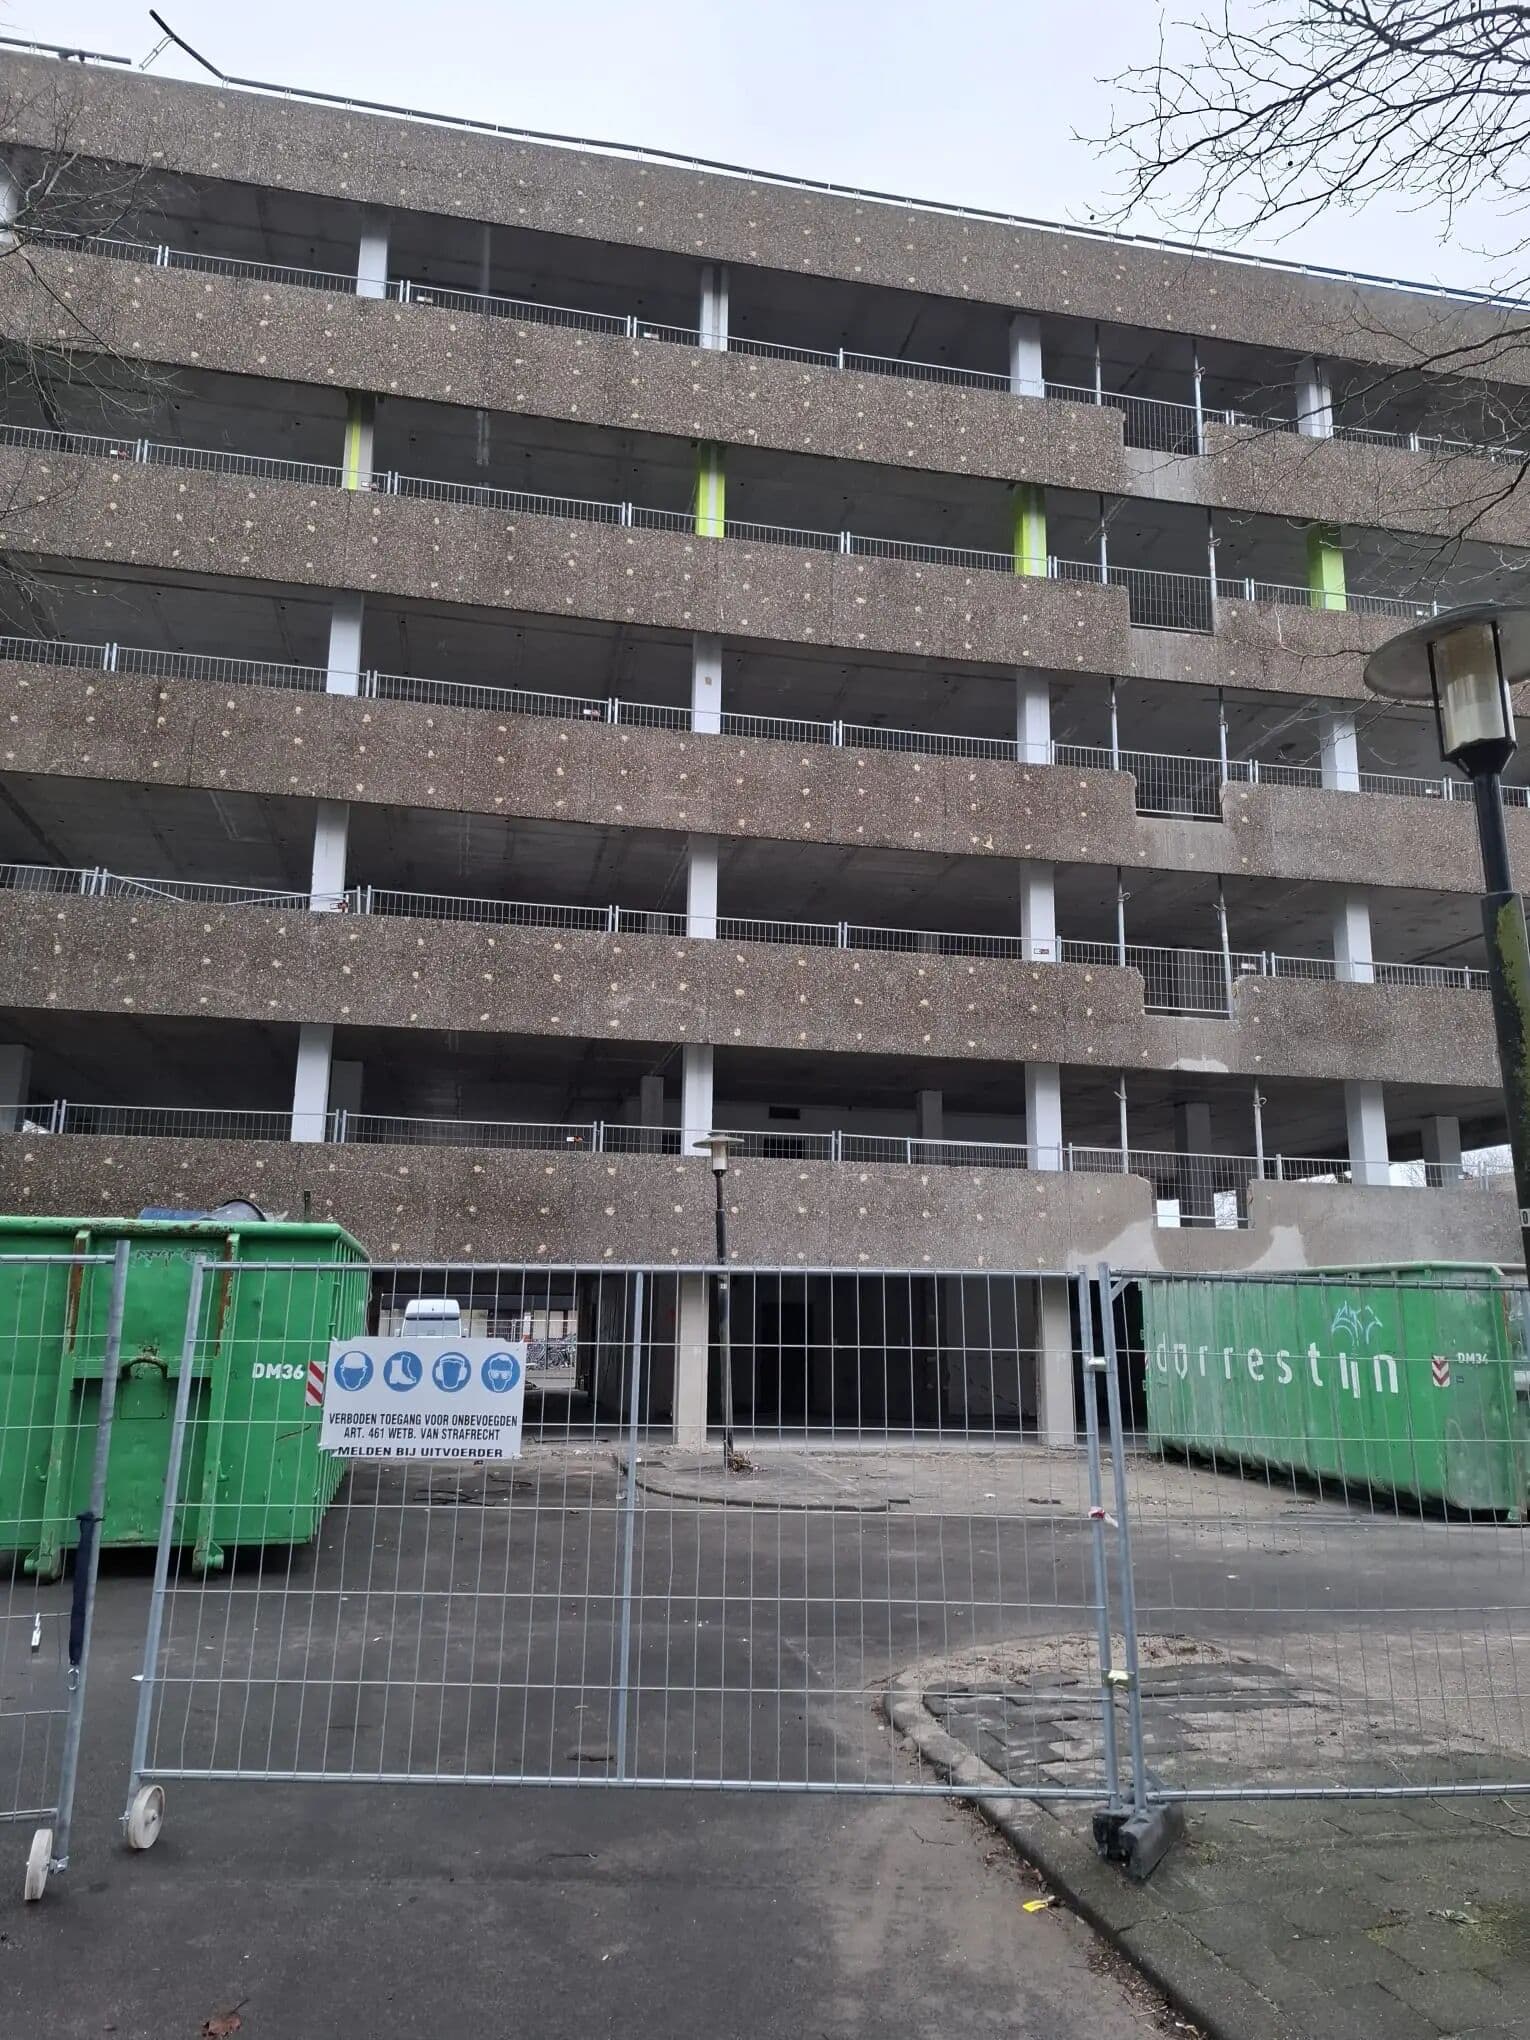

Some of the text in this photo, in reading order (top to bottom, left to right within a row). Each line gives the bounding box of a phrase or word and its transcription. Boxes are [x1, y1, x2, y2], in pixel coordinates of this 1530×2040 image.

[252, 1362, 304, 1380] DM36
[329, 1413, 518, 1427] VERBODEN TOEGANG VOOR ONBEVOEGDEN
[344, 1427, 500, 1440] ART. 461 WETB. VAN STRAFRECHT
[338, 1446, 503, 1458] MELDEN BIJ UITVOERDER
